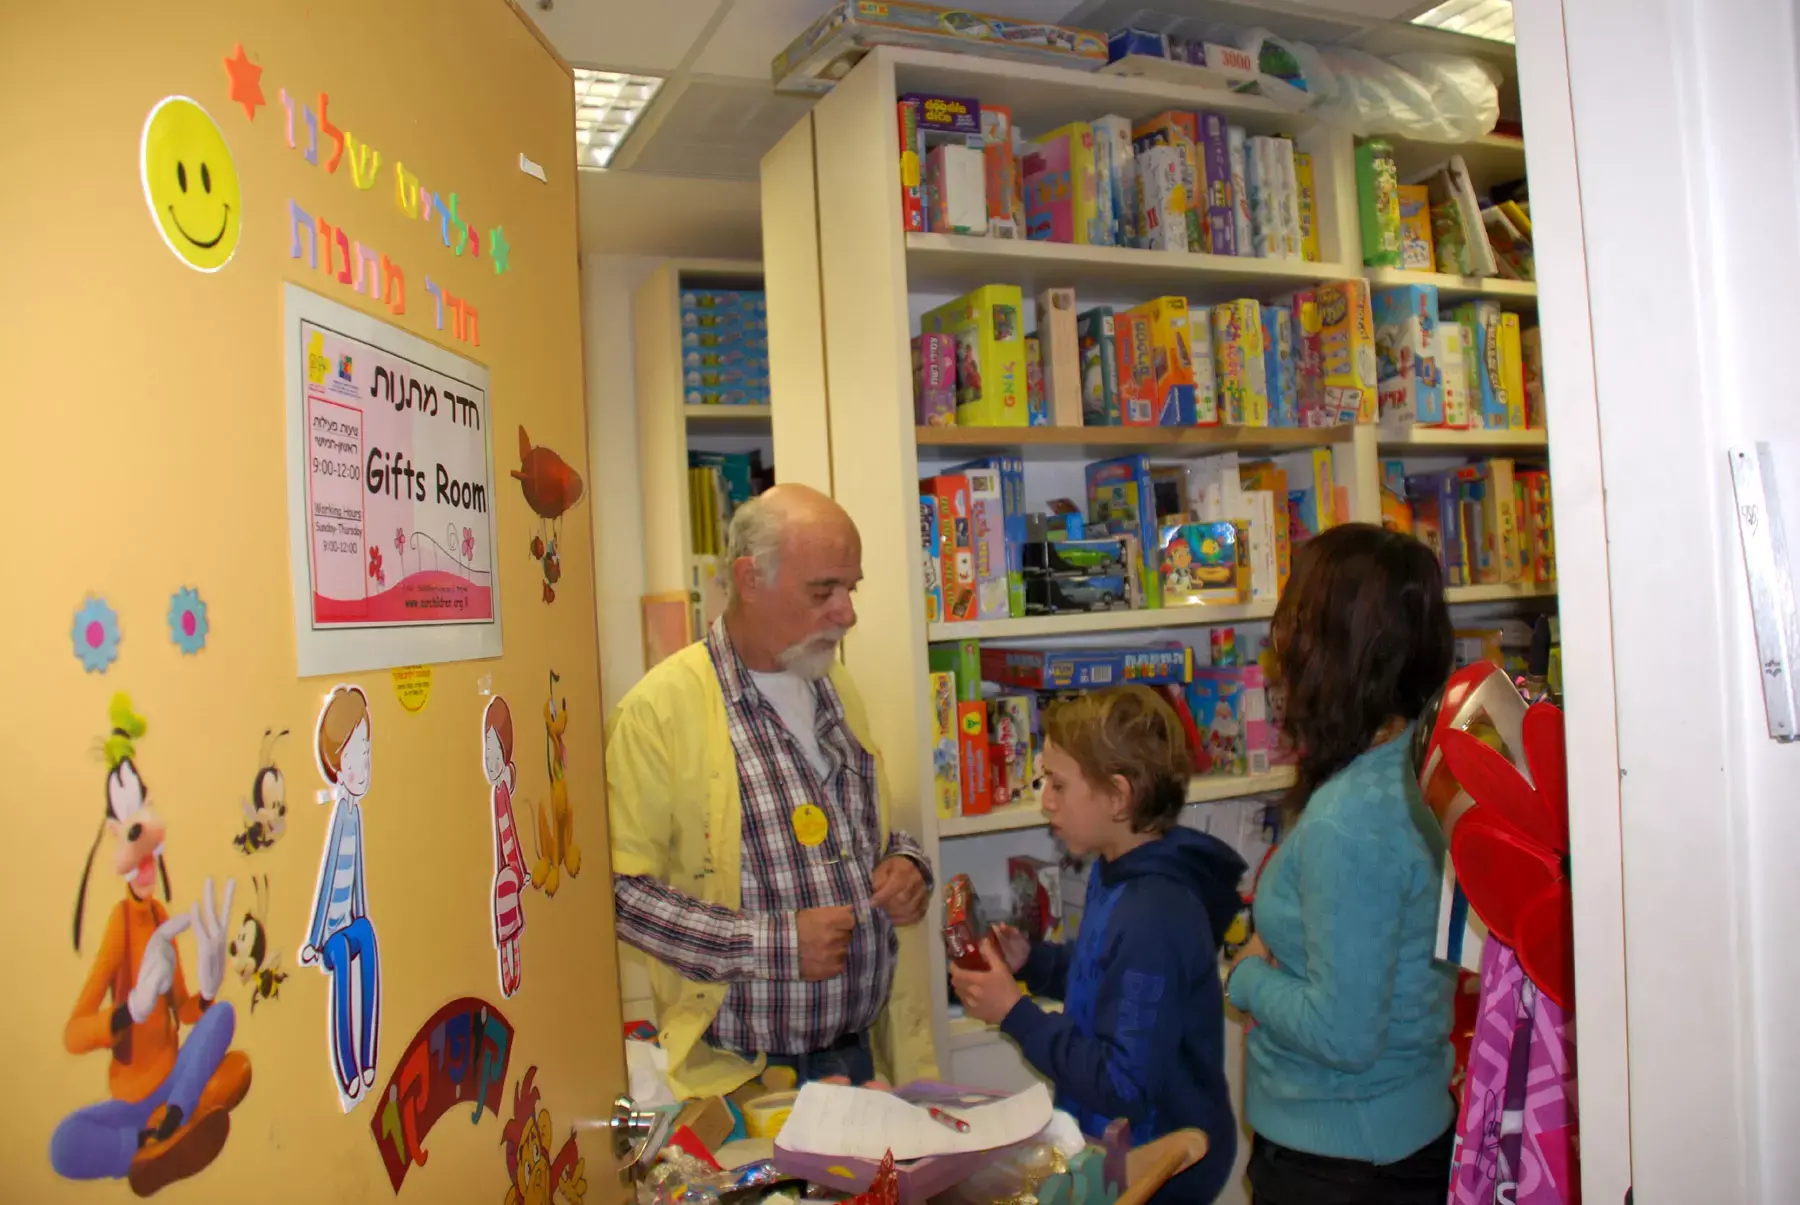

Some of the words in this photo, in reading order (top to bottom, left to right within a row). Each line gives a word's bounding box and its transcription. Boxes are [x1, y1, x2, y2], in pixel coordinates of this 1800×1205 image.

[279, 88, 382, 190] שלנו
[289, 198, 405, 315] מתנות
[425, 275, 480, 347] חדר
[370, 365, 438, 417] מתנות
[444, 390, 480, 430] חדר
[313, 457, 360, 480] 9:00-12:00
[366, 446, 427, 501] Gifts
[436, 463, 487, 513] Room
[314, 502, 341, 517] Working
[343, 506, 362, 519] Hours
